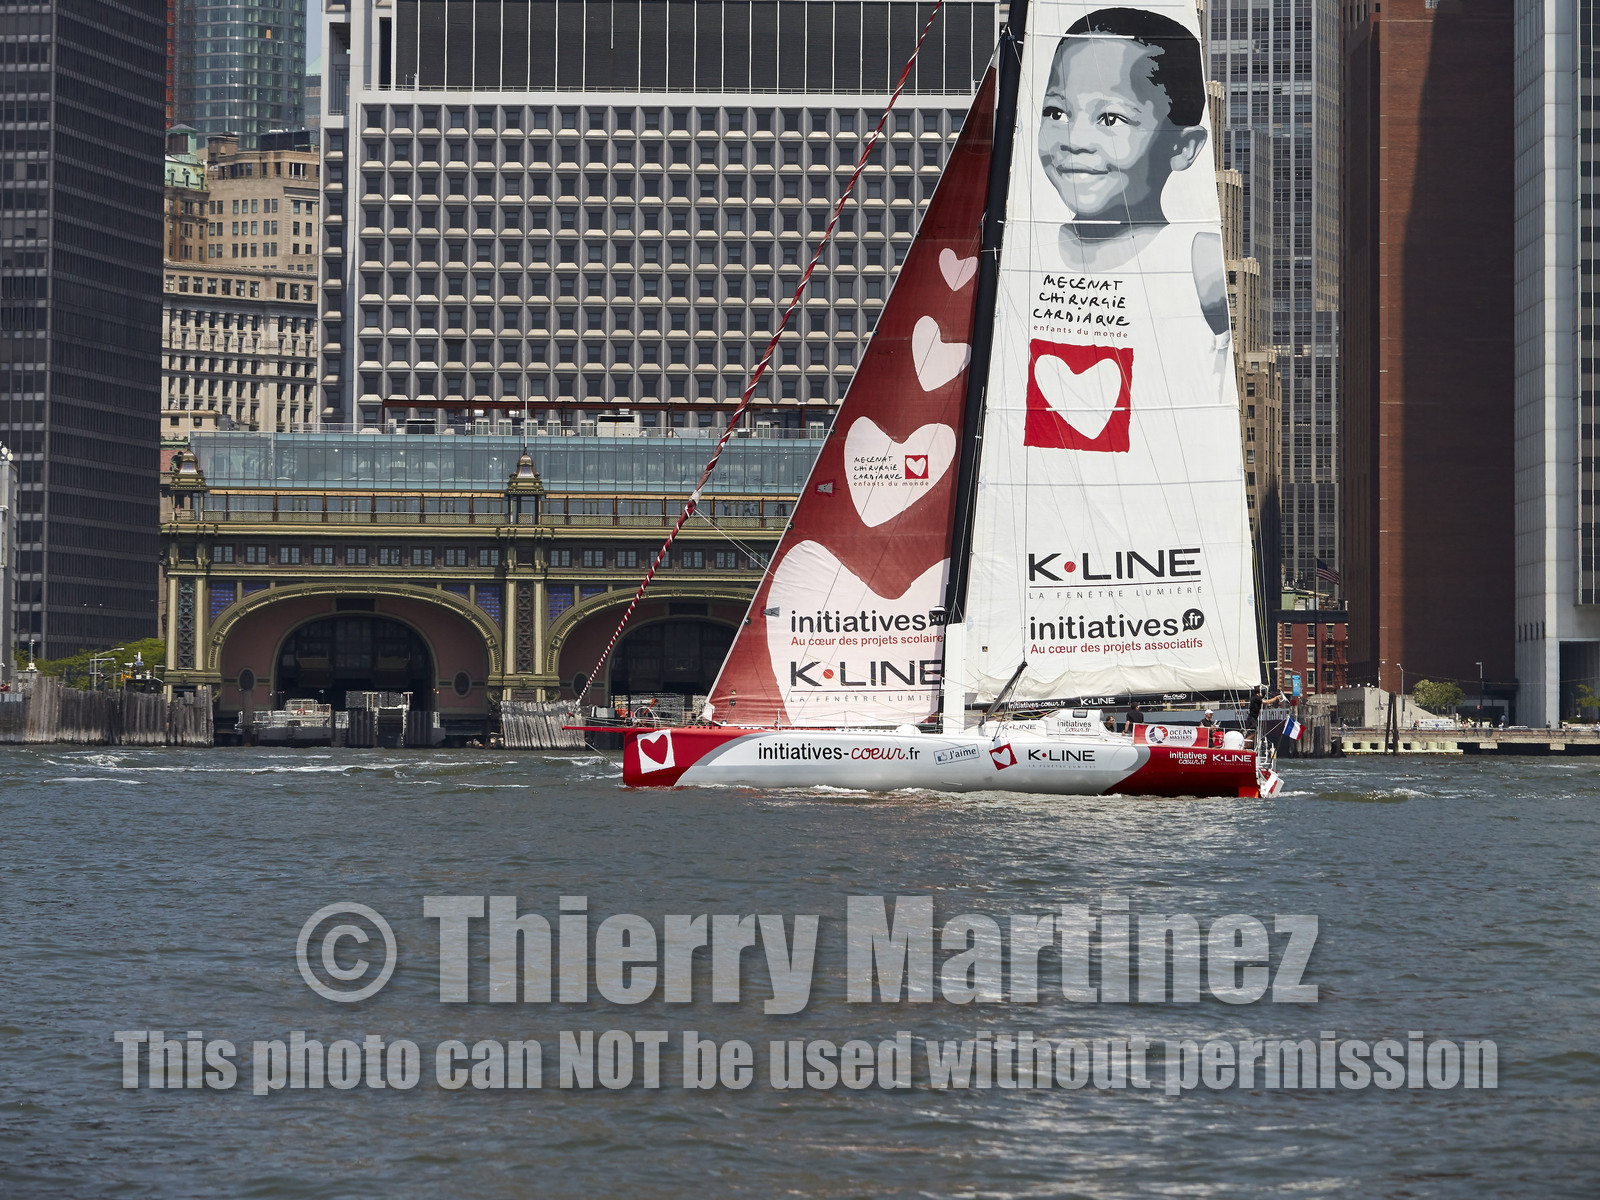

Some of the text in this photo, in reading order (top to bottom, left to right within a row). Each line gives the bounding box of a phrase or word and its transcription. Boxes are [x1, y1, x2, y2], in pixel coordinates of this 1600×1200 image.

[1043, 274, 1123, 291] MECENAT
[1033, 325, 1072, 334] enfants
[1077, 328, 1089, 336] du
[1057, 589, 1123, 599] FENÊTRE
[1136, 586, 1202, 596] LUMIÈRE
[791, 610, 927, 633] initiatives
[791, 636, 805, 645] Au
[839, 636, 858, 645] des
[861, 635, 898, 647] projets
[1030, 644, 1045, 654] Au
[1081, 643, 1100, 653] des
[1103, 641, 1141, 654] projets
[1144, 637, 1203, 650] associatifs
[1169, 751, 1207, 759] initiatives
